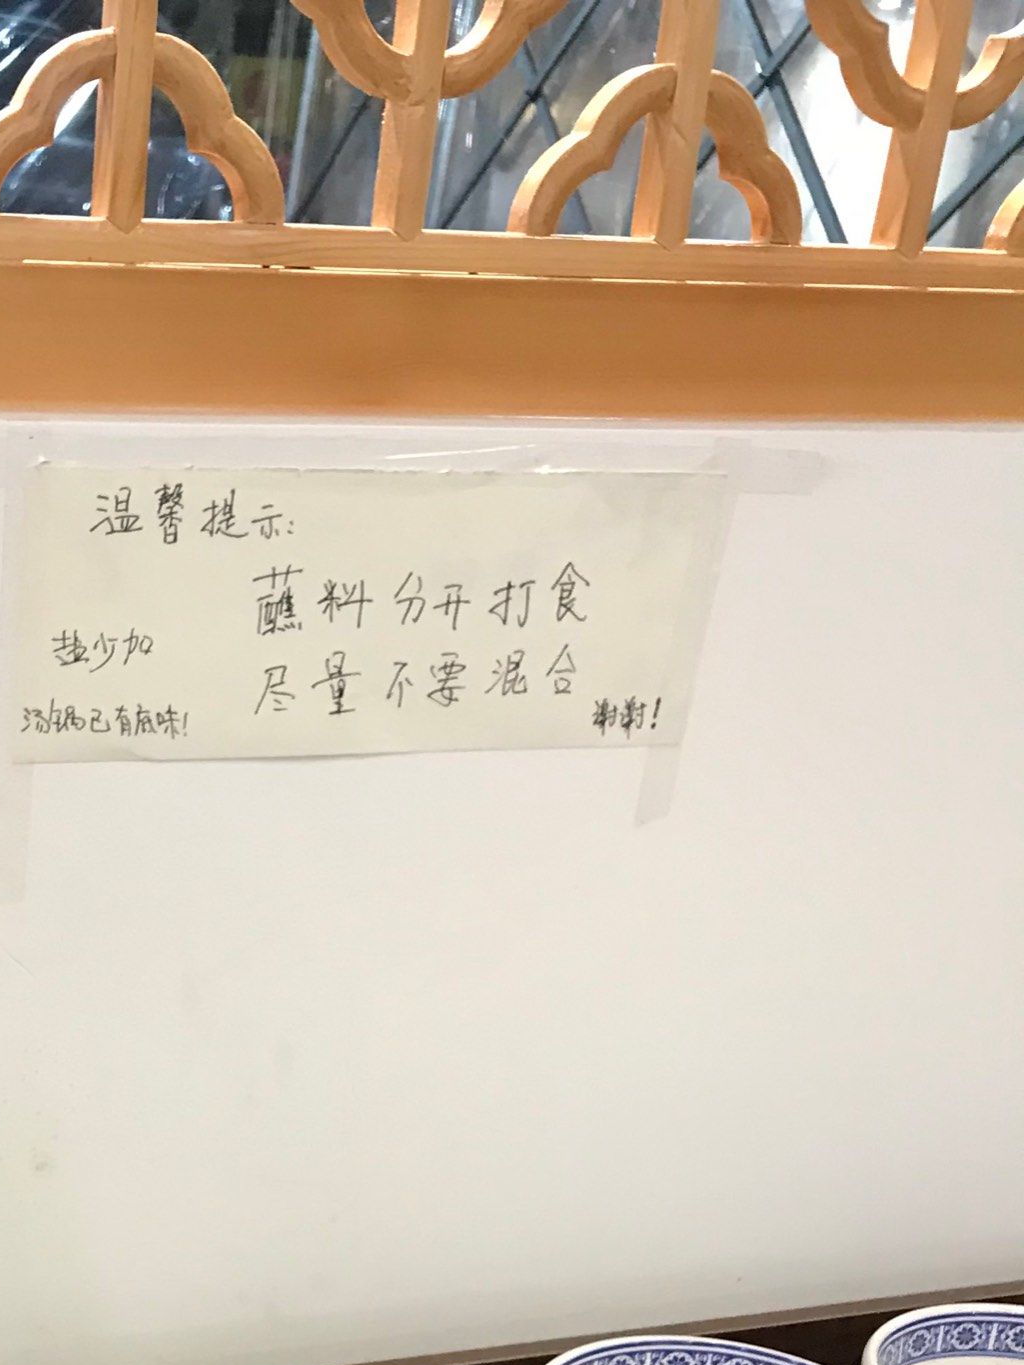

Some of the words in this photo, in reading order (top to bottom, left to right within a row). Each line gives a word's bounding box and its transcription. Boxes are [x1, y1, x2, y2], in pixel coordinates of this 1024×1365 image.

[252, 562, 590, 634] 蘸料分开打食
[254, 644, 577, 716] 尽量不要混合
